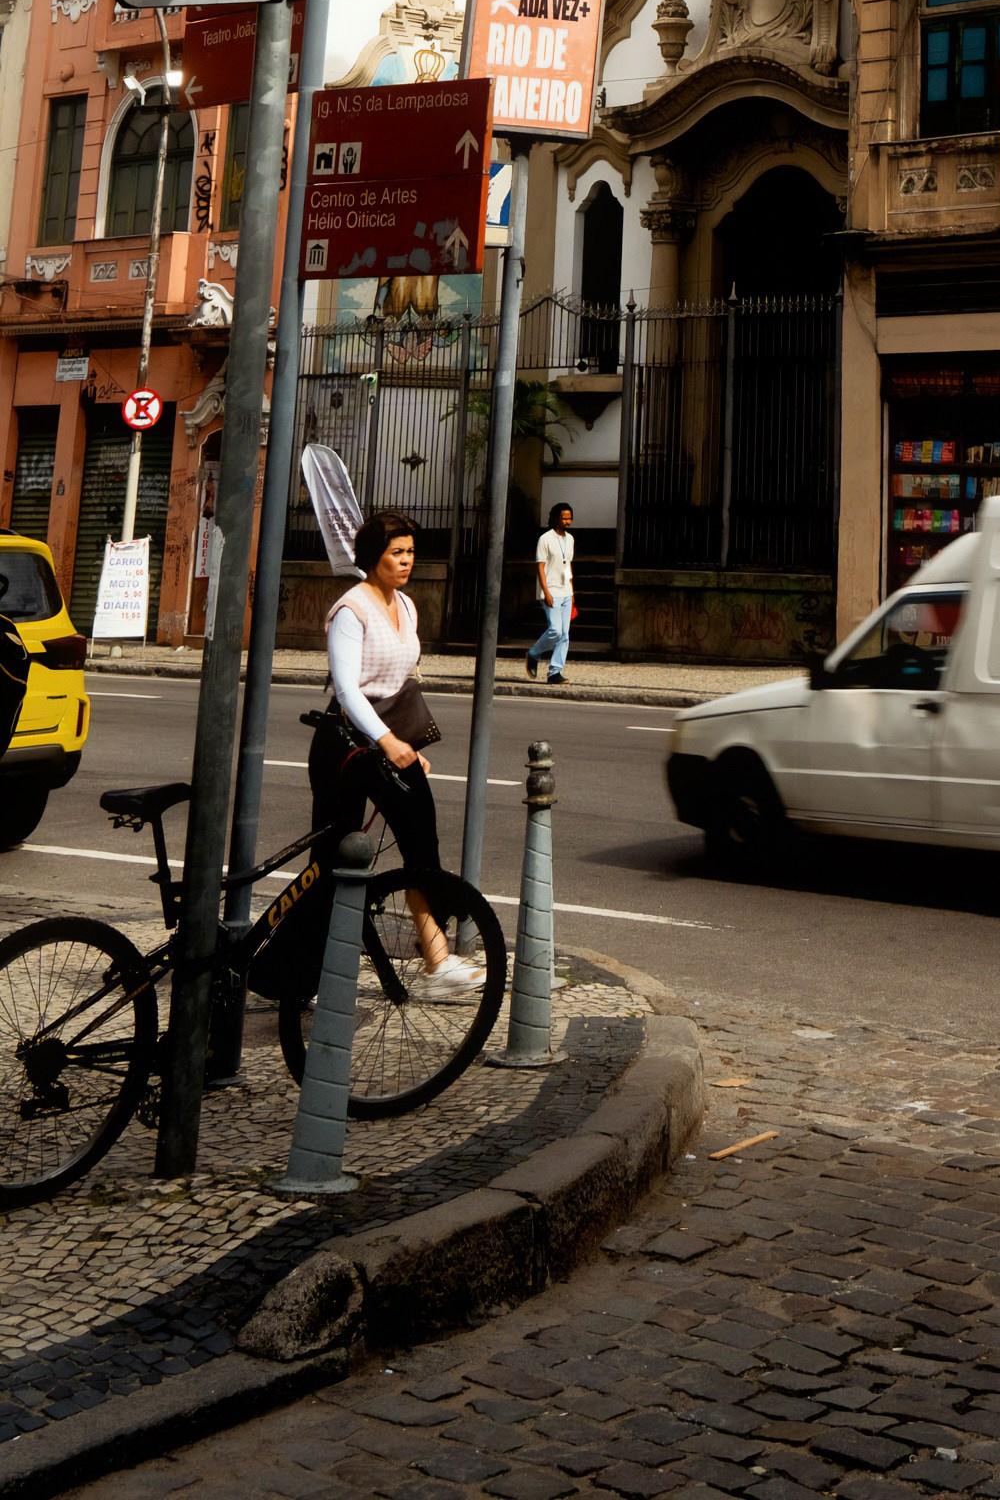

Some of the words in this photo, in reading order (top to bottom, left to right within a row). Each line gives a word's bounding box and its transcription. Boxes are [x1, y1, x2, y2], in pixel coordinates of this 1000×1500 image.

[202, 30, 231, 47] Teatro
[486, 22, 532, 68] RIO
[536, 26, 568, 70] DE
[366, 95, 383, 112] da
[387, 90, 469, 112] Lampadosa
[486, 74, 582, 125] ANEIRO
[310, 189, 355, 209] Centro
[359, 189, 377, 207] de
[380, 187, 417, 204] Artes
[307, 211, 342, 230] Hélio
[346, 210, 396, 229] Oiticica
[199, 521, 209, 577] IGREJA
[109, 557, 143, 566] CARRO
[109, 579, 140, 588] MOTO
[268, 861, 320, 928] CALOI
